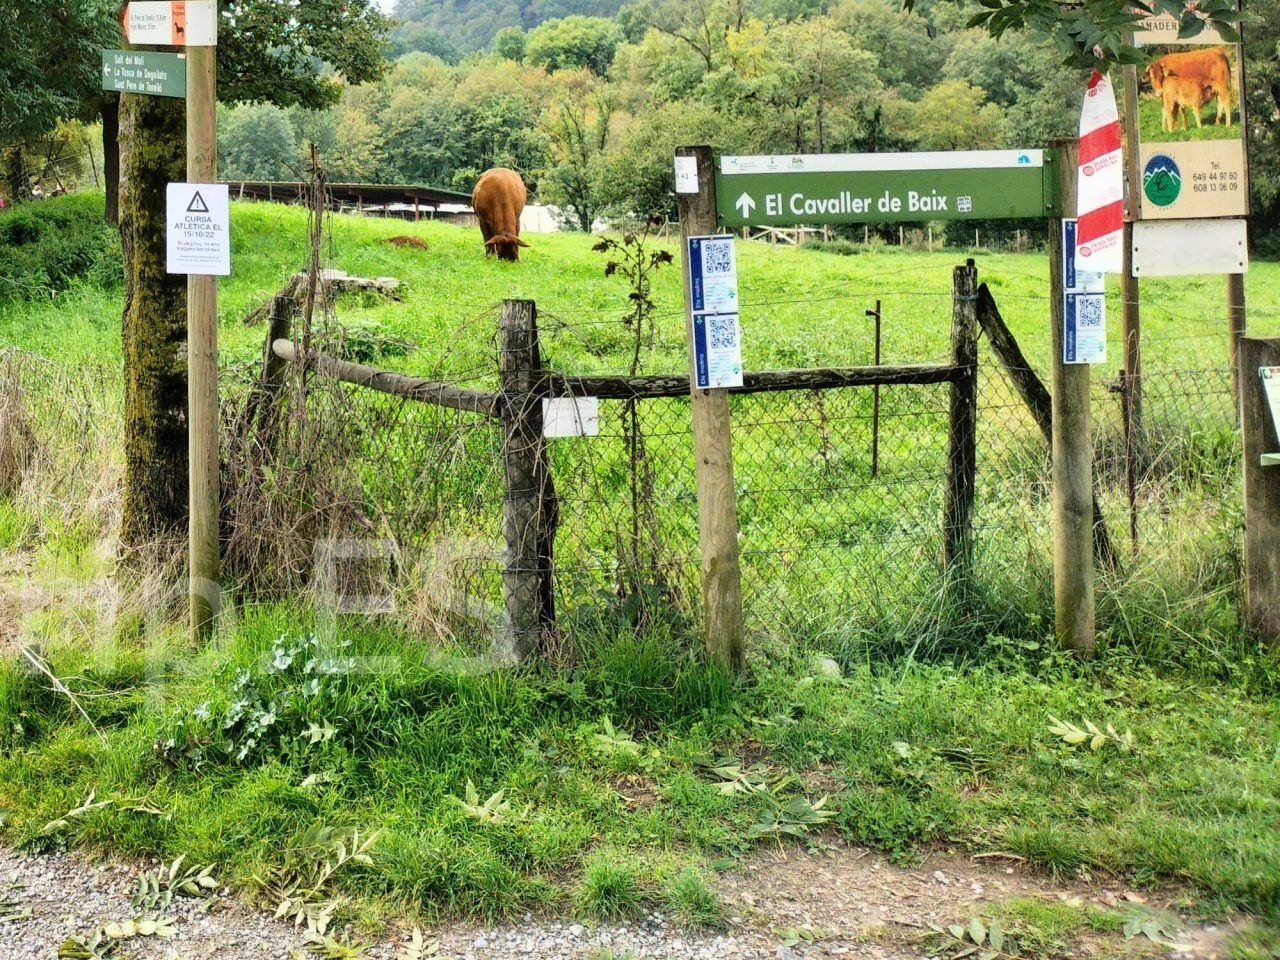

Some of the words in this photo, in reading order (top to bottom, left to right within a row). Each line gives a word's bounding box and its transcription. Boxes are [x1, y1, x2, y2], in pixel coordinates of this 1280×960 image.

[1193, 172, 1206, 181] 649
[1209, 172, 1217, 180] 44
[1220, 172, 1227, 180] 97
[1229, 171, 1238, 180] 60
[1194, 184, 1207, 192] 608
[1210, 183, 1216, 191] 13
[1229, 182, 1237, 191] 09
[765, 193, 783, 216] El
[789, 191, 872, 216] Cavaller
[878, 190, 902, 213] de
[908, 189, 948, 212] Baix
